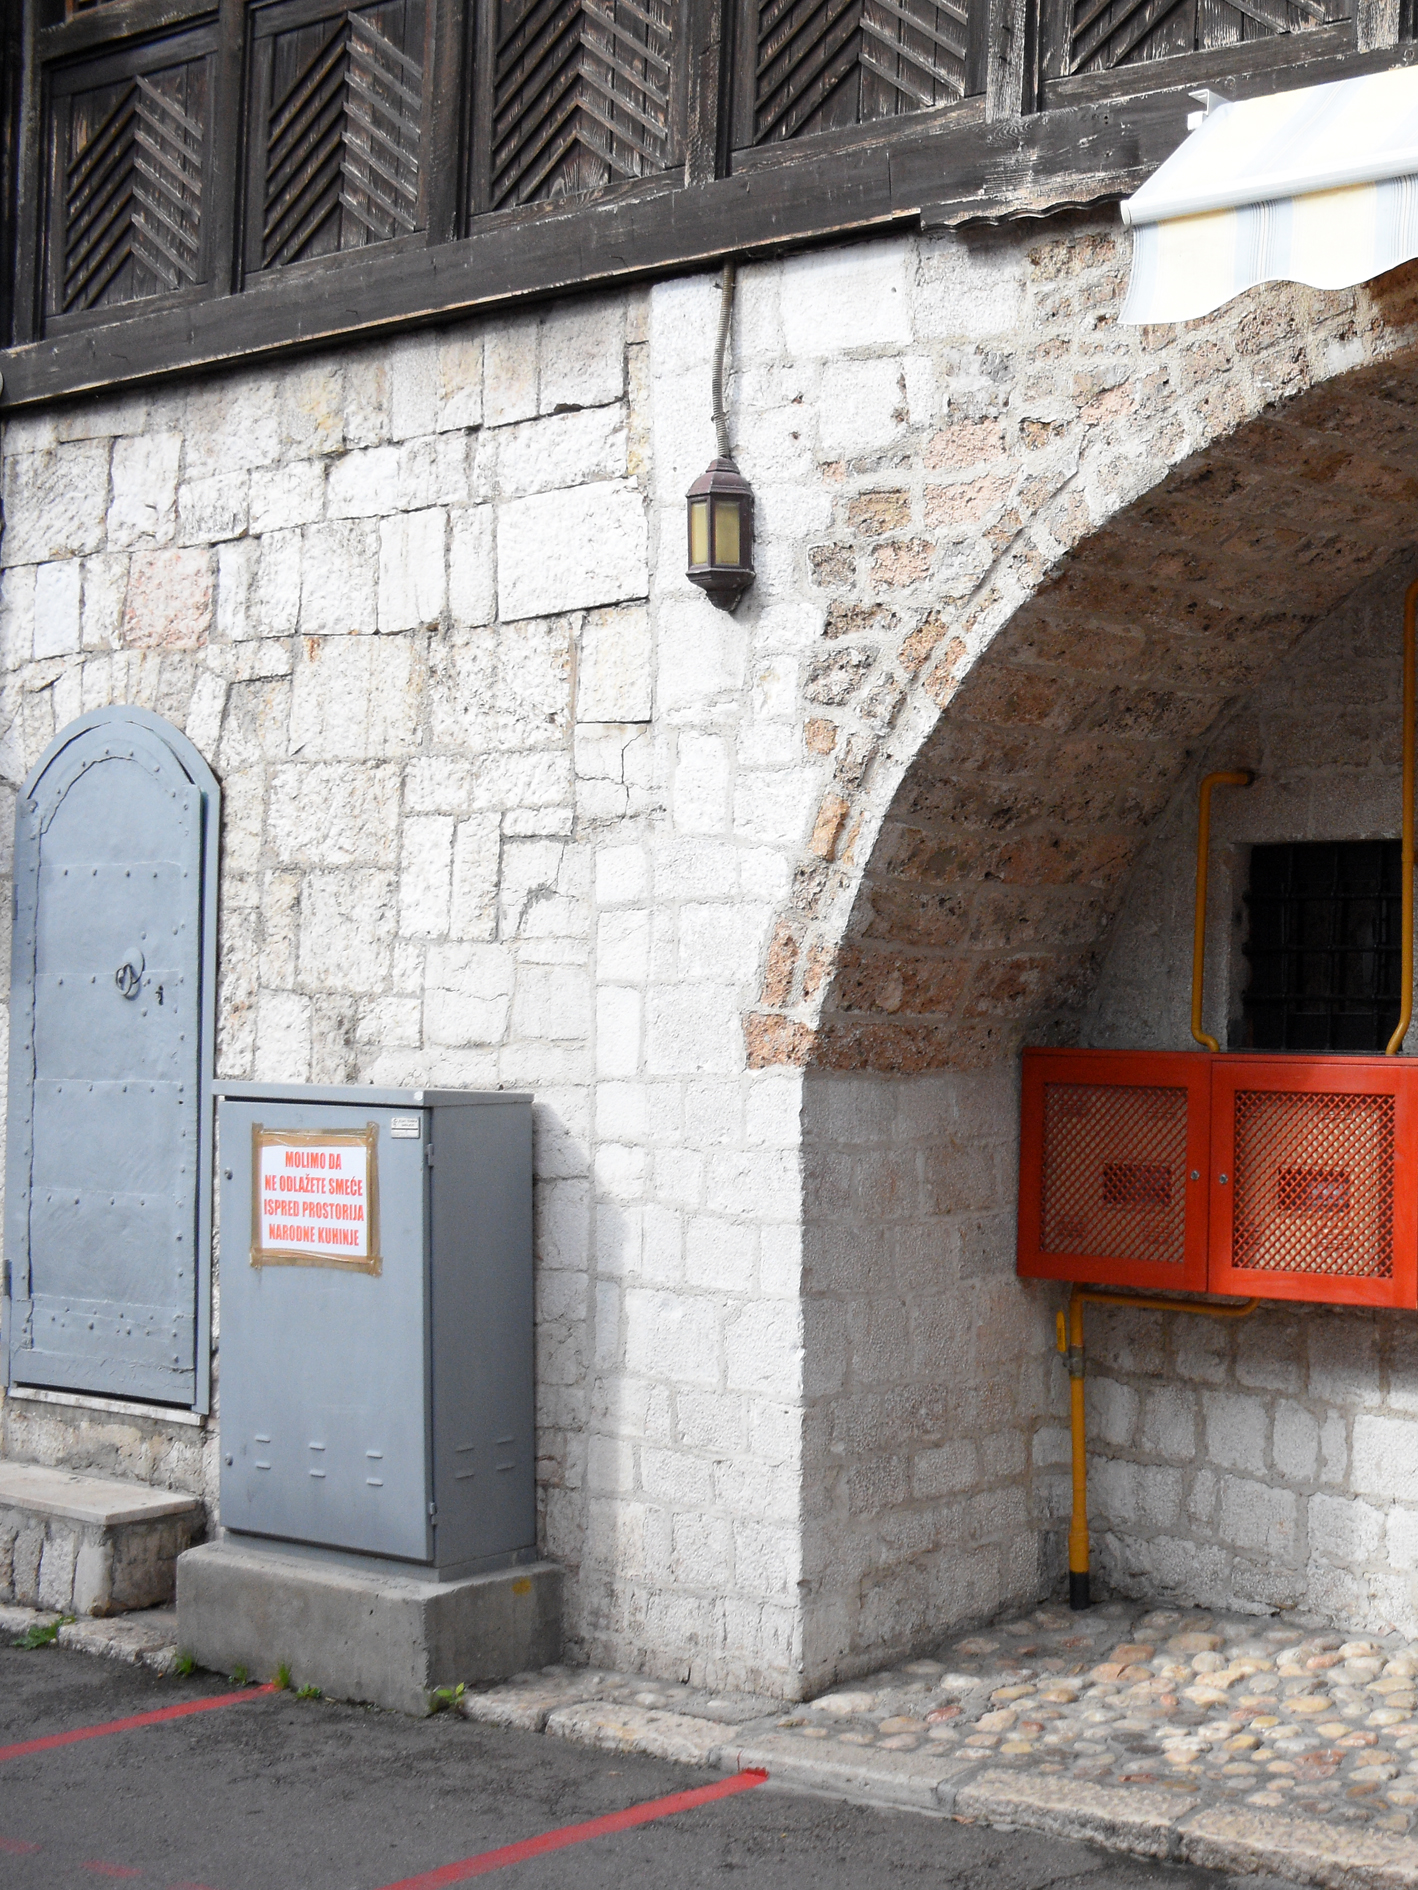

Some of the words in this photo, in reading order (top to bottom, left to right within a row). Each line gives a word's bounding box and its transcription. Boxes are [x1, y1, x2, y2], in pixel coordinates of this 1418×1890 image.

[285, 1151, 326, 1169] MOLIMO
[329, 1153, 342, 1170] DA
[265, 1174, 277, 1191] NE
[279, 1173, 326, 1194] ODLAŽETE
[329, 1176, 362, 1196] SMEĆE
[264, 1199, 299, 1217] ISPRED
[302, 1201, 364, 1221] PROSTORIJA
[269, 1223, 315, 1242] NARODNE
[318, 1227, 359, 1246] KUHINJE
